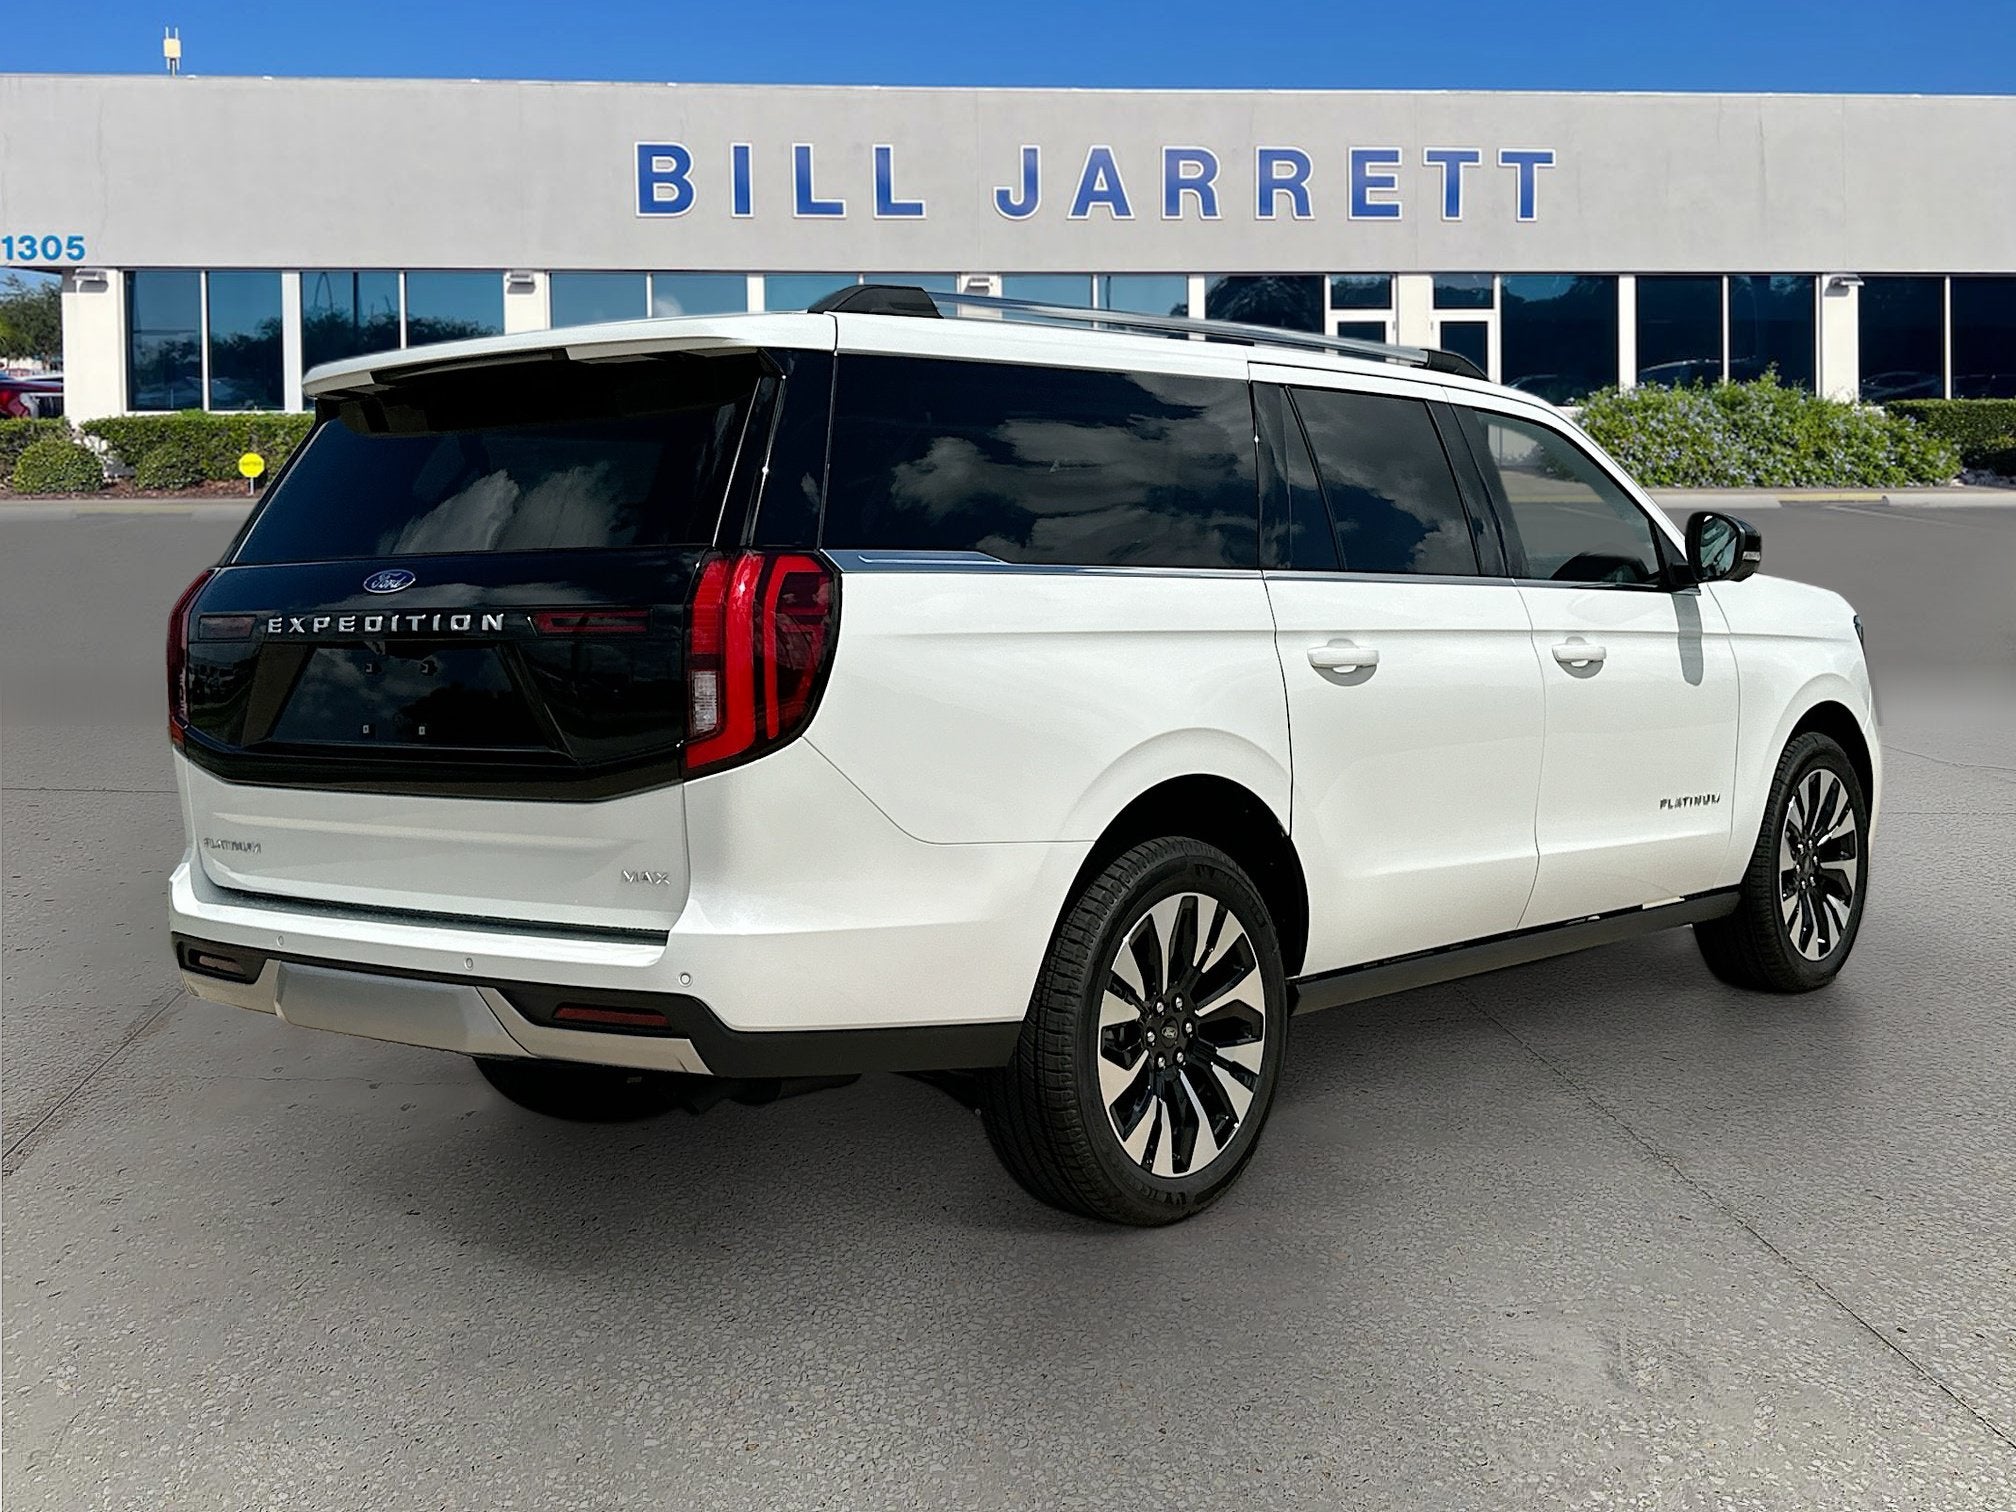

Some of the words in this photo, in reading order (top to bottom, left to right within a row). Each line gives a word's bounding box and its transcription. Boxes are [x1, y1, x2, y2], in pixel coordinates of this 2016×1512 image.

[634, 140, 925, 221] BILL
[992, 143, 1557, 223] JARRETT
[1, 234, 86, 261] 1305
[368, 571, 409, 590] Ford
[267, 613, 504, 634] EXPEDITION
[1659, 792, 1721, 810] PLATINUM
[621, 869, 671, 885] MAX
